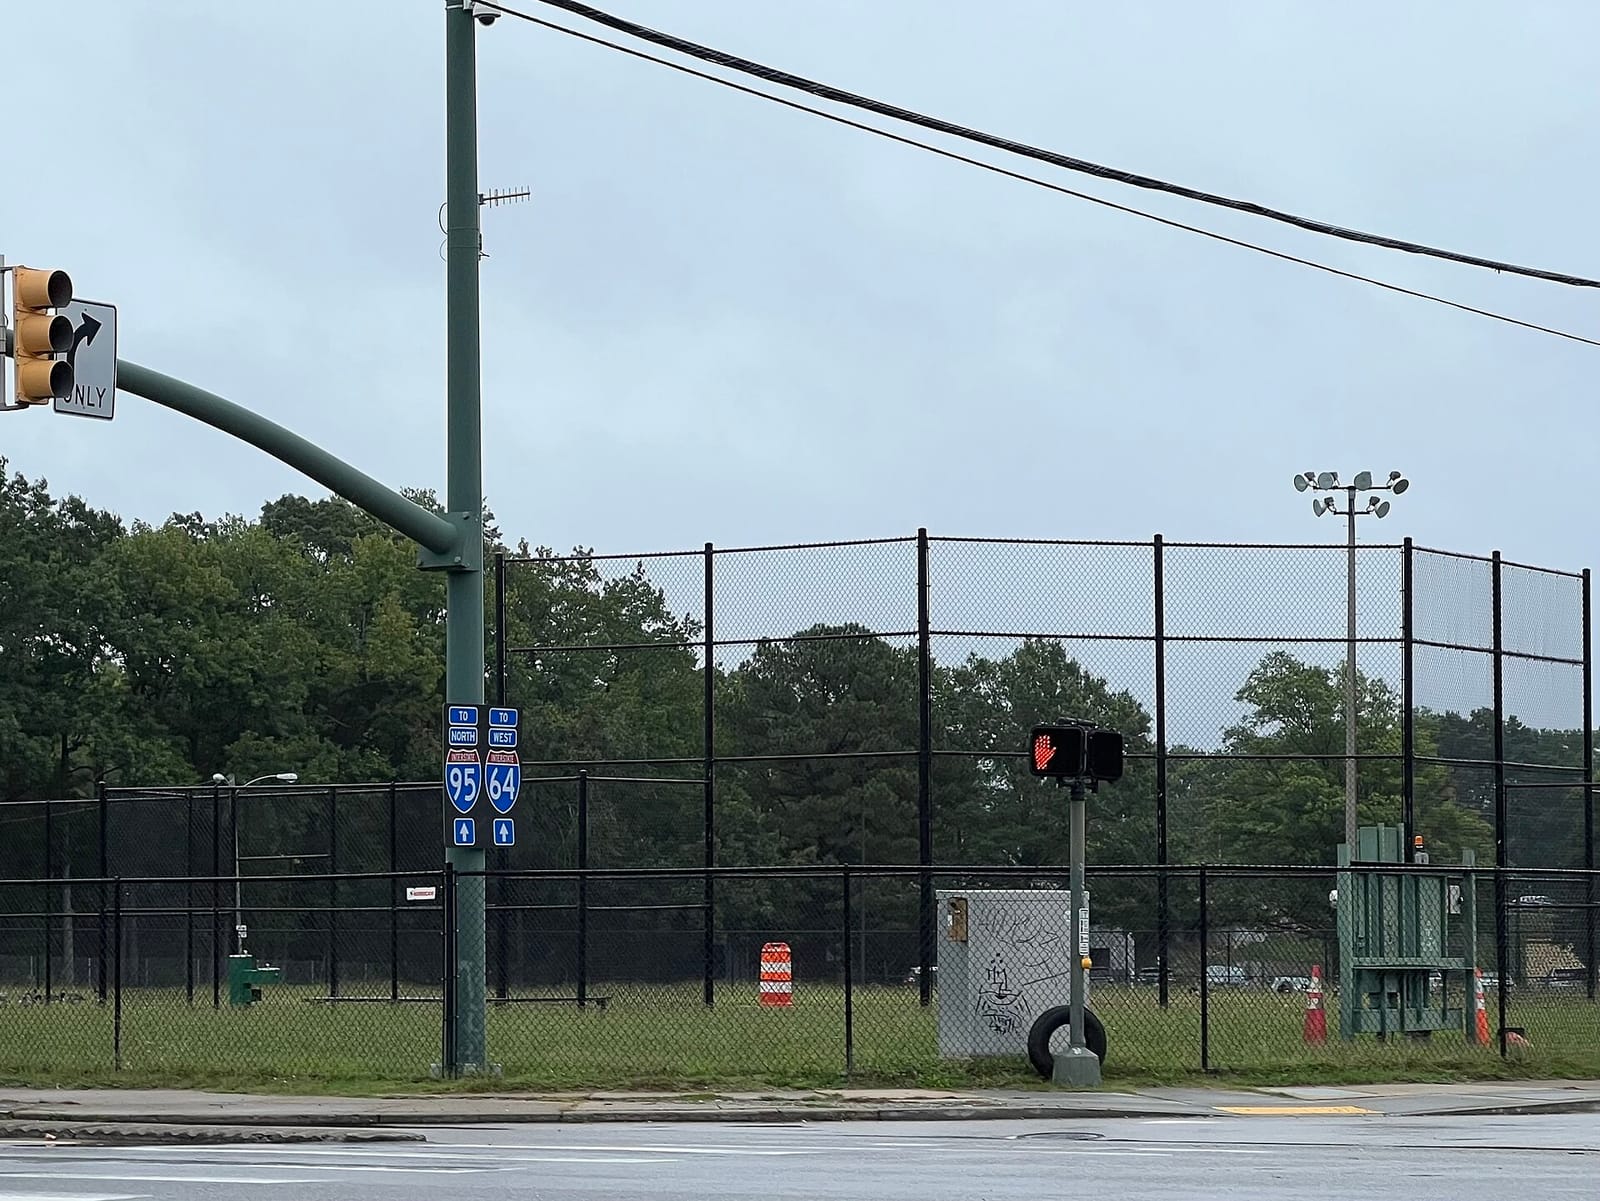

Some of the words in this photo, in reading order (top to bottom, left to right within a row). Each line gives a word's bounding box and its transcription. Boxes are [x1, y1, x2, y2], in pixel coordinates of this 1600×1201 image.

[459, 711, 468, 721] TO
[499, 712, 508, 722] TO
[451, 730, 475, 742] NORTH
[493, 732, 513, 743] WEST
[450, 768, 476, 801] 95
[489, 767, 515, 800] 64
